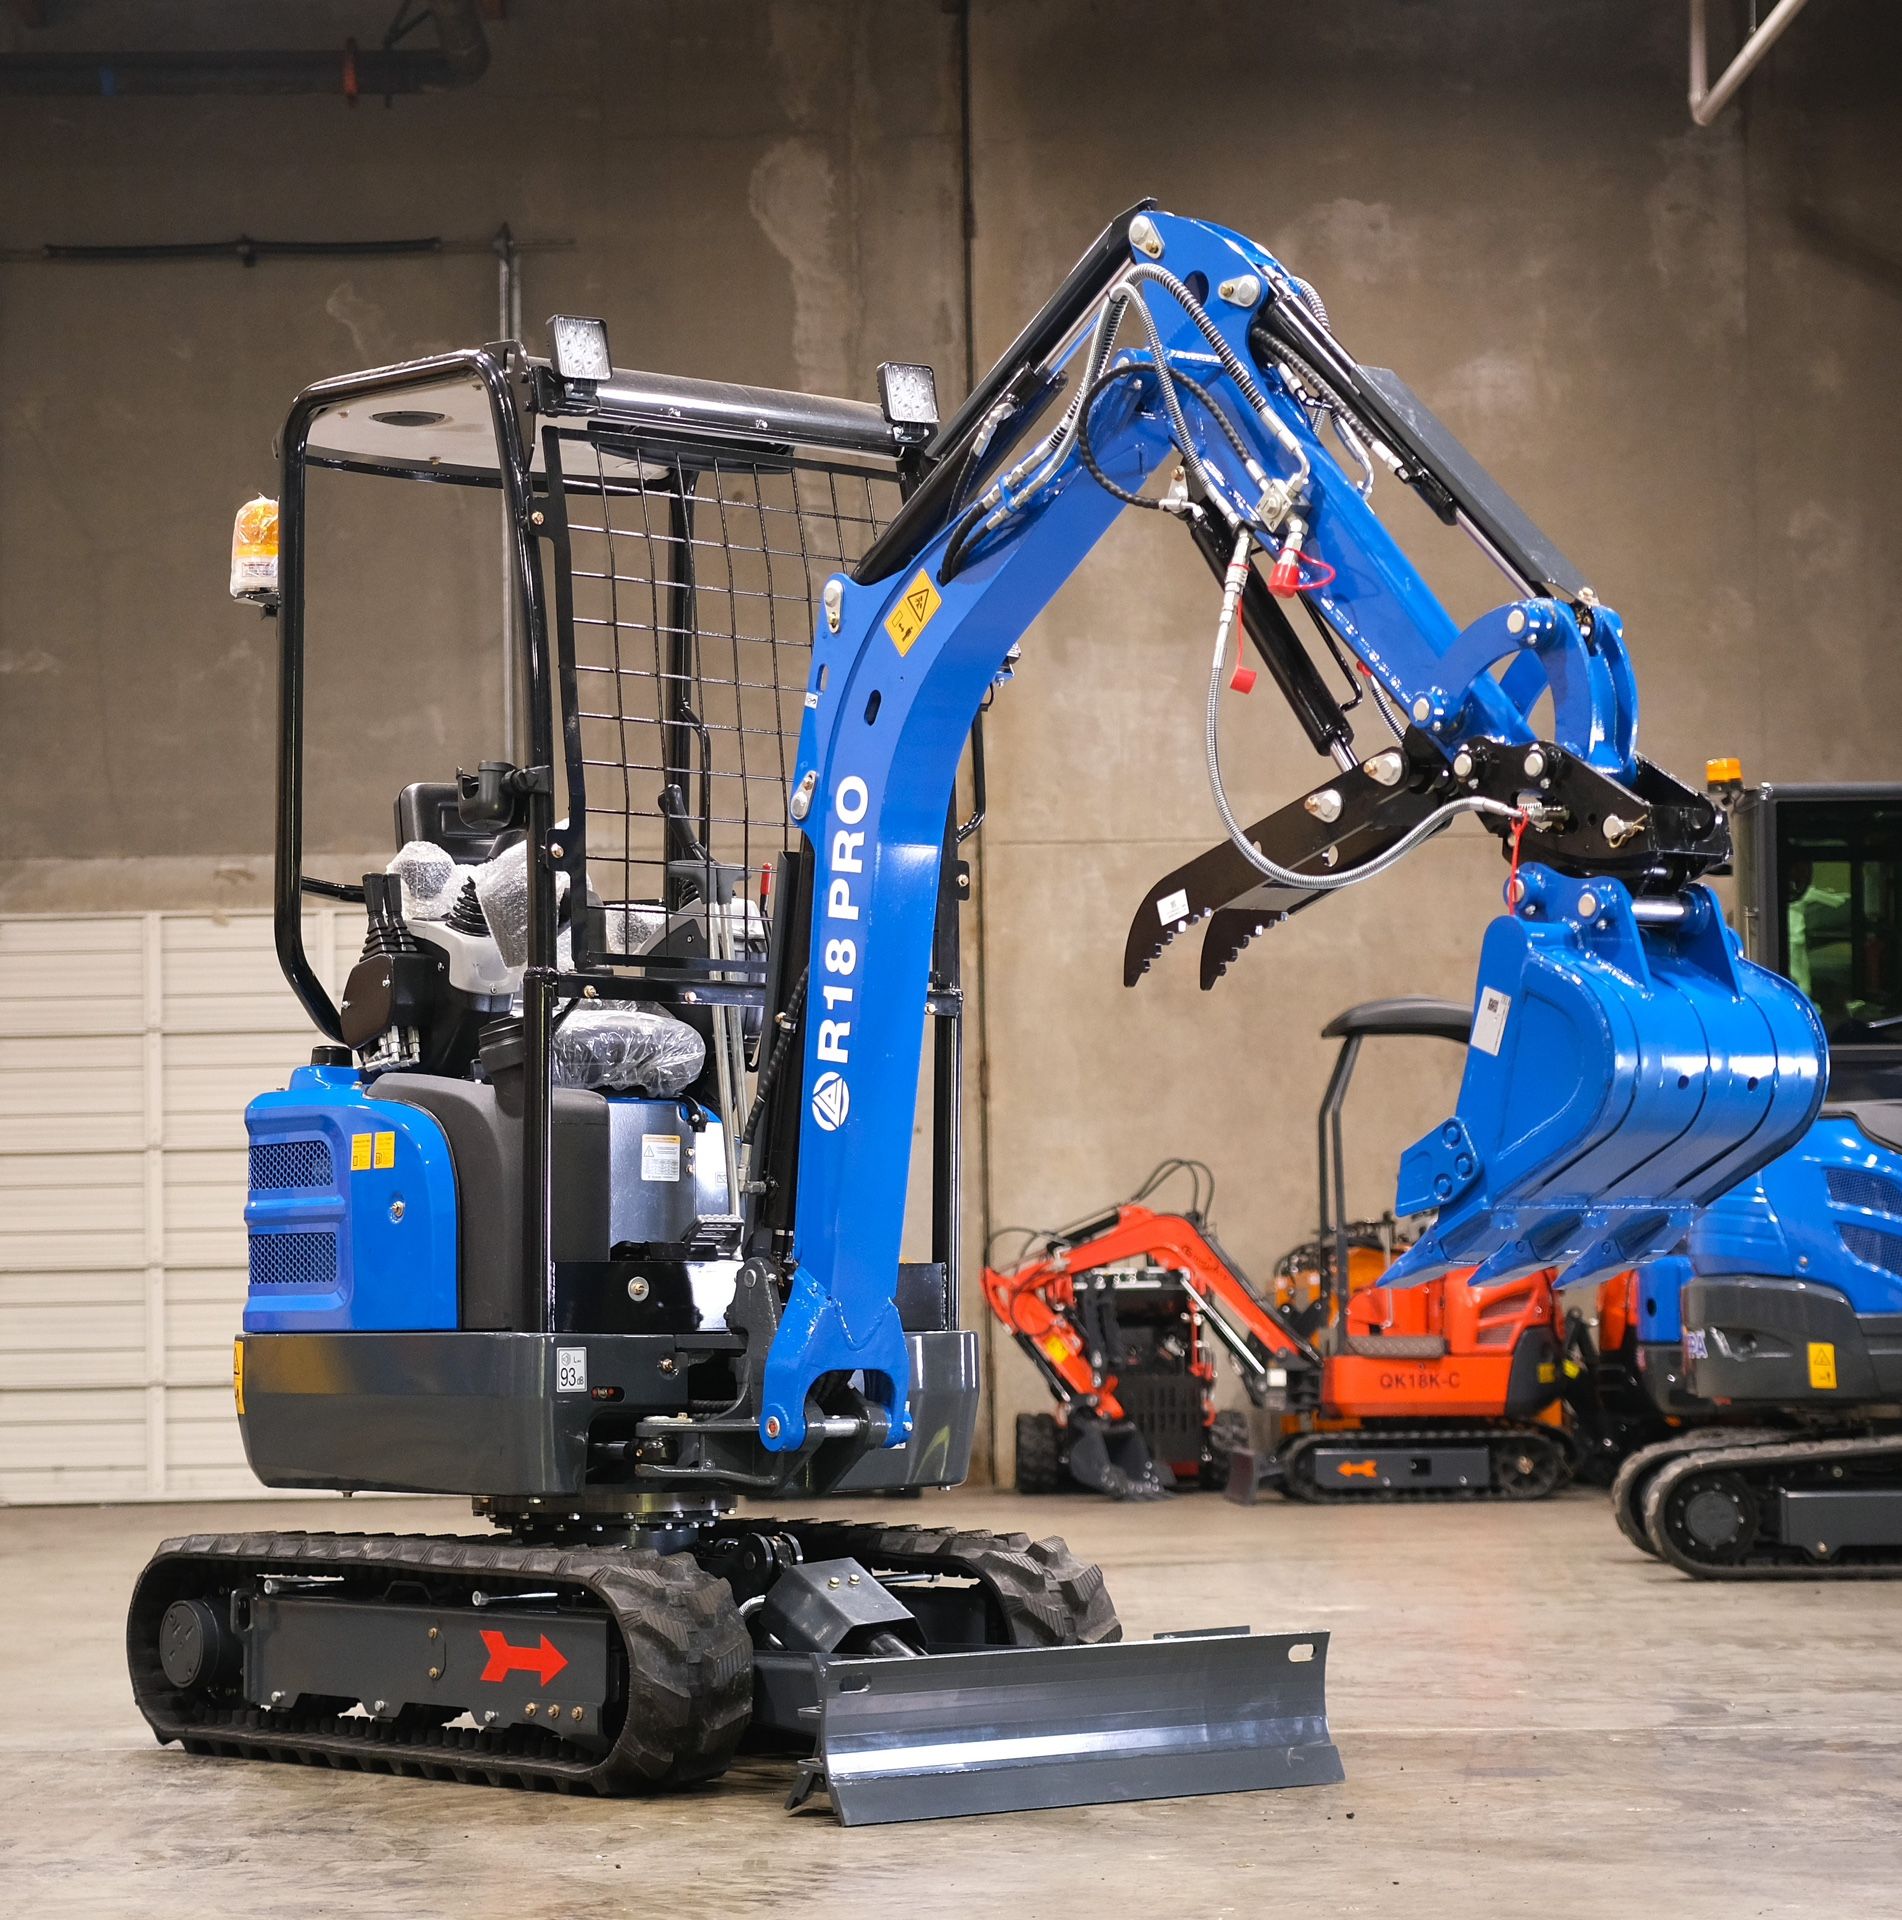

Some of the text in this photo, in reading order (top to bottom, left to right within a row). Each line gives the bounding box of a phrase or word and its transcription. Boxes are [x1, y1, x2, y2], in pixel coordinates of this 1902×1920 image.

[817, 775, 869, 1064] R18 PRO
[560, 1367, 585, 1387] 93 dB
[1380, 1371, 1461, 1389] QK18K-C
